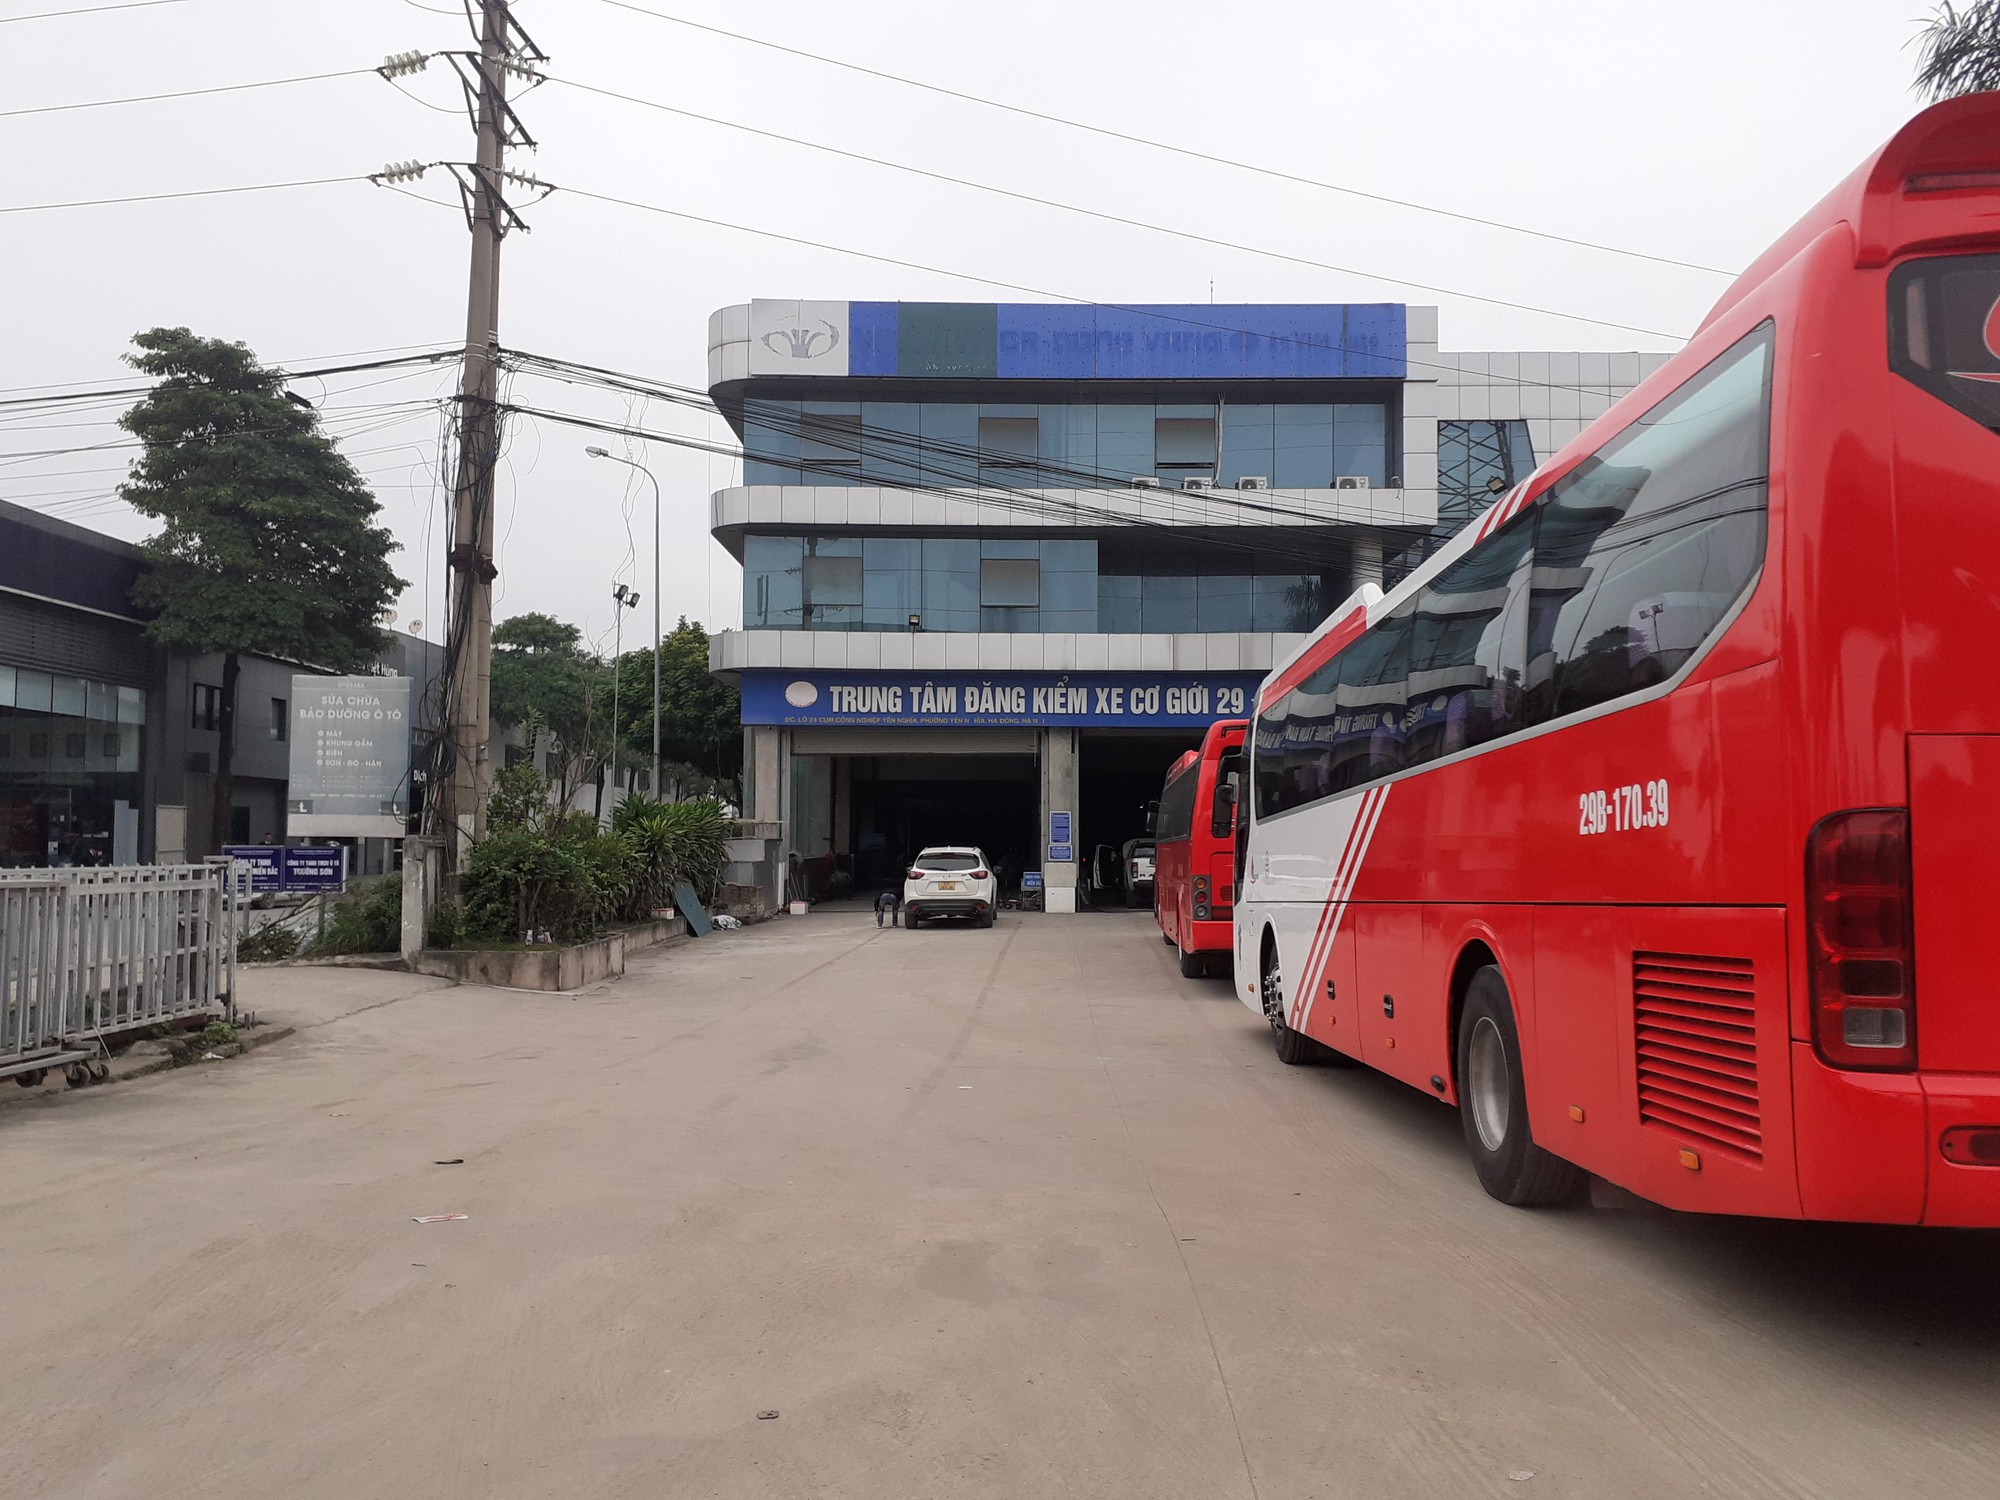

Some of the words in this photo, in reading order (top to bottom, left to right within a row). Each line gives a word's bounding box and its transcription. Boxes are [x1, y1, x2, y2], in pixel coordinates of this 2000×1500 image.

[321, 693, 344, 705] SỬA
[347, 694, 381, 706] CHỮA
[829, 685, 902, 714] TRUNG
[910, 681, 957, 714] TÂM
[964, 681, 1026, 714] ĐĂNG
[1032, 675, 1088, 714] KIỂM
[1095, 687, 1124, 715] XE
[1130, 685, 1161, 715] CƠ
[1166, 681, 1210, 715] GIỚI
[1216, 687, 1245, 715] 29
[299, 706, 324, 718] BẢO
[327, 707, 371, 719] DƯỠNG
[373, 708, 383, 719] Ô
[386, 708, 402, 720] TÔ
[325, 729, 343, 737] MÁY
[325, 739, 353, 747] KHUNG
[325, 749, 343, 758] ĐIỆN
[413, 769, 427, 784] Dịch
[1579, 778, 1669, 835] 29B-170.39
